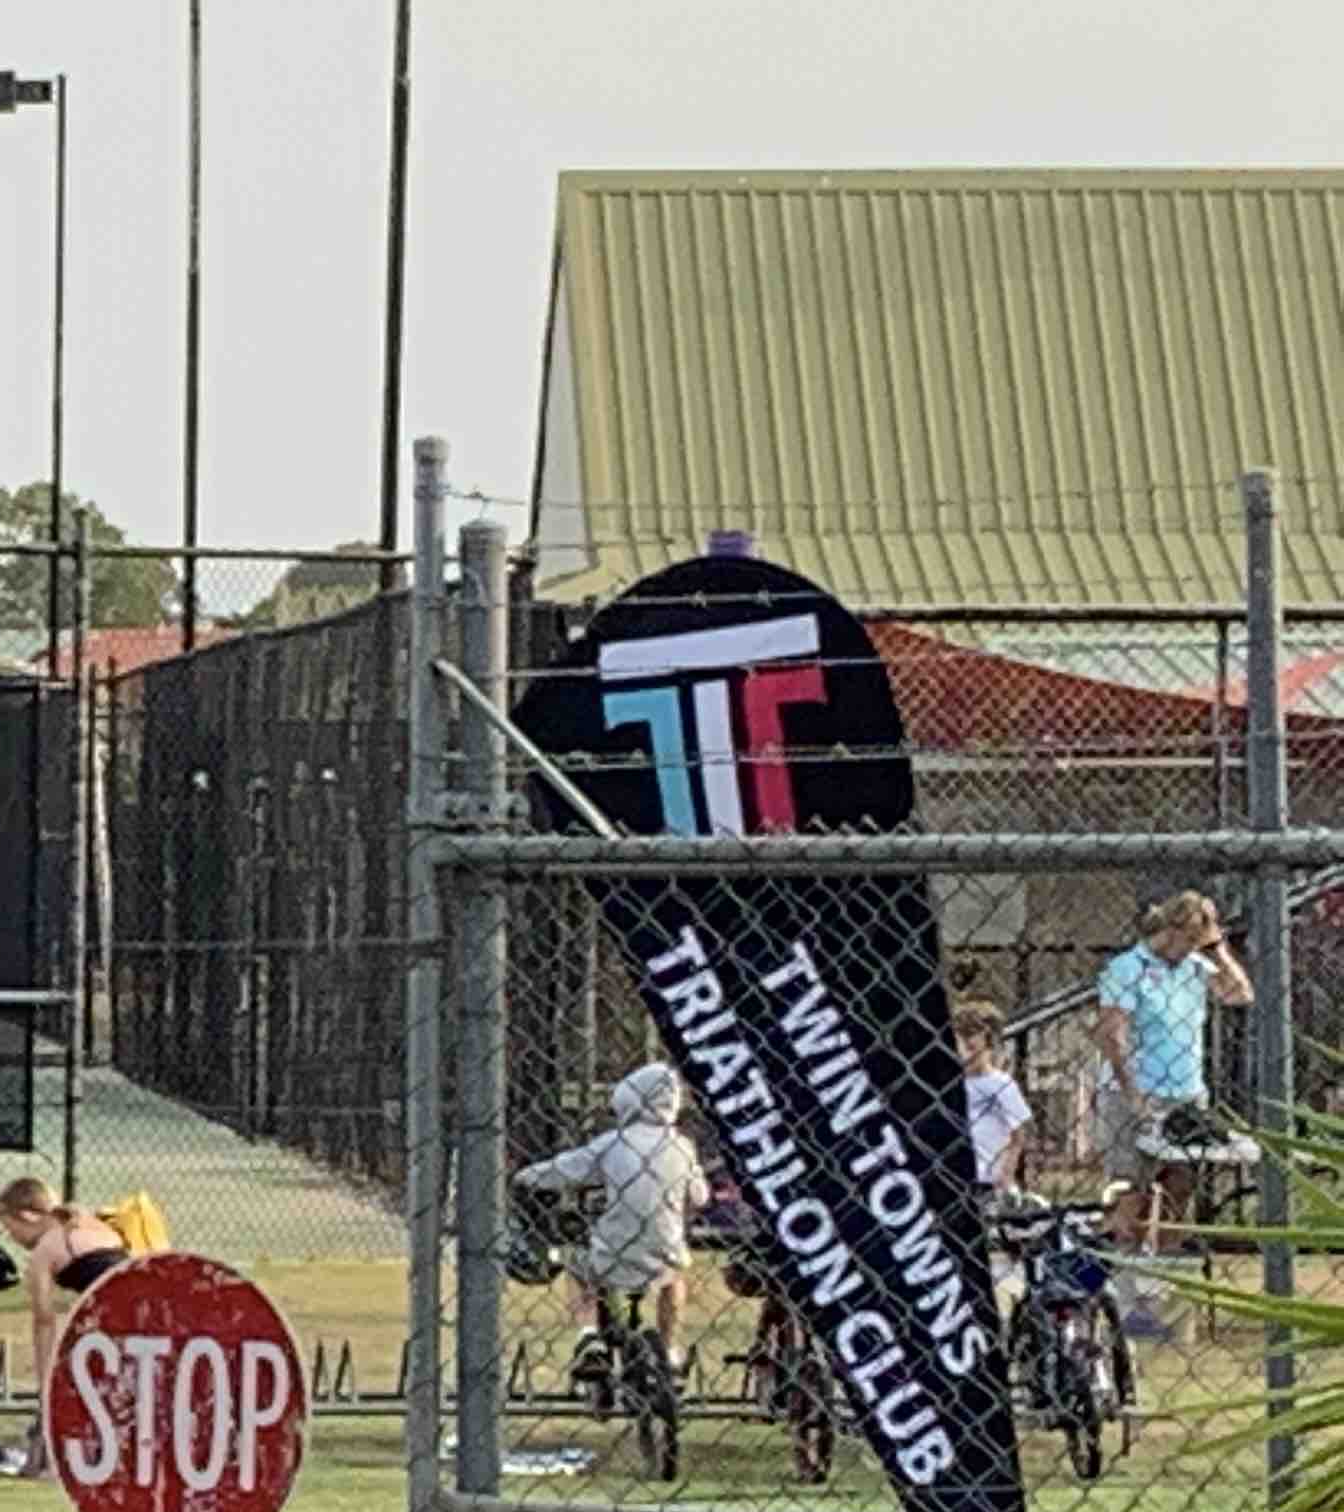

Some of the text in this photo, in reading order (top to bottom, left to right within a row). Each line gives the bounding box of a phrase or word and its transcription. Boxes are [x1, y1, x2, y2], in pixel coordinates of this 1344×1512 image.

[647, 925, 954, 1485] TRIATHLON CLUB
[762, 941, 988, 1374] TWIN TOWNS
[65, 1331, 290, 1492] STOP
